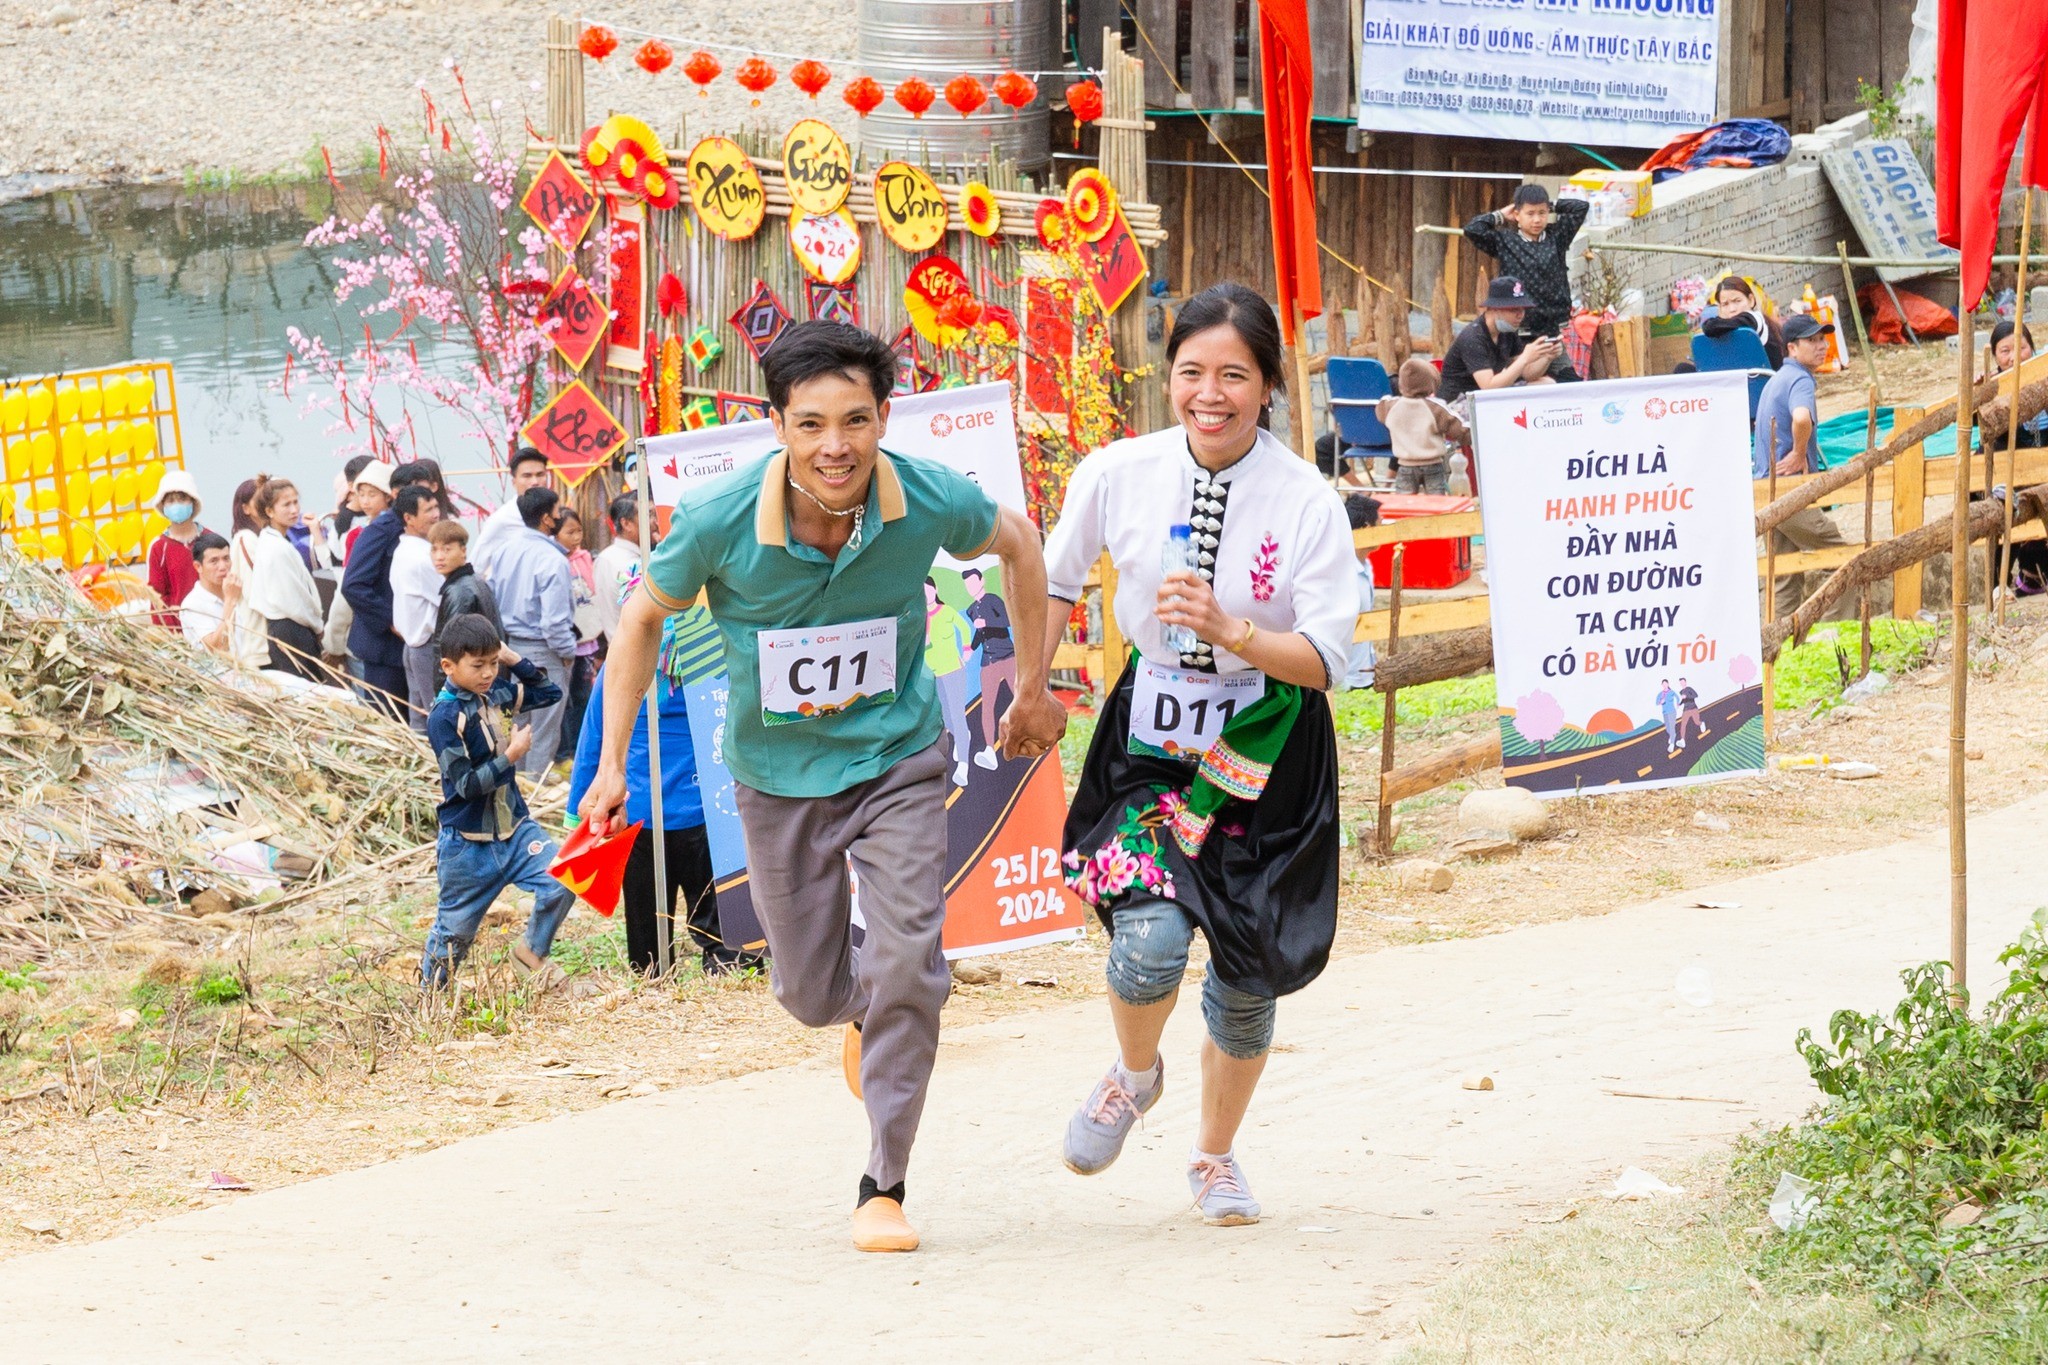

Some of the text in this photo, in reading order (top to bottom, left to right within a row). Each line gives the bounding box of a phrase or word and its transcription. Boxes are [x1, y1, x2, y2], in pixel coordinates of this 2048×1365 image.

[1366, 18, 1399, 40] GIẢI
[1407, 23, 1450, 43] KHÁT
[1458, 23, 1480, 46] ĐỒ
[1488, 26, 1533, 49] UỐNG
[1551, 28, 1579, 52] ẨM
[1587, 35, 1629, 58] THỰC
[1637, 36, 1670, 57] TÂY
[1678, 36, 1712, 60] BẮC
[1552, 77, 1570, 90] Tam
[1542, 101, 1582, 115] Website:
[695, 160, 762, 222] Xuân
[879, 167, 946, 225] Thìn
[955, 410, 995, 431] care
[1533, 413, 1583, 430] Canada
[1669, 398, 1709, 415] care
[683, 458, 734, 478] Canada
[1567, 444, 1668, 480] ĐÍCH LÀ
[1545, 482, 1694, 527] HẠNH PHÚC
[1567, 521, 1678, 558] ĐẦY NHÀ
[1547, 562, 1702, 599] CON ĐƯỜNG
[1576, 604, 1680, 636] TA CHẠY
[826, 635, 840, 643] care
[1542, 634, 1716, 677] CÓ BÀ VỚI TÔI
[788, 651, 868, 696] C11
[1195, 677, 1210, 685] care
[1154, 692, 1237, 736] D11
[991, 846, 1060, 888] 25/2
[996, 887, 1066, 927] 2024
